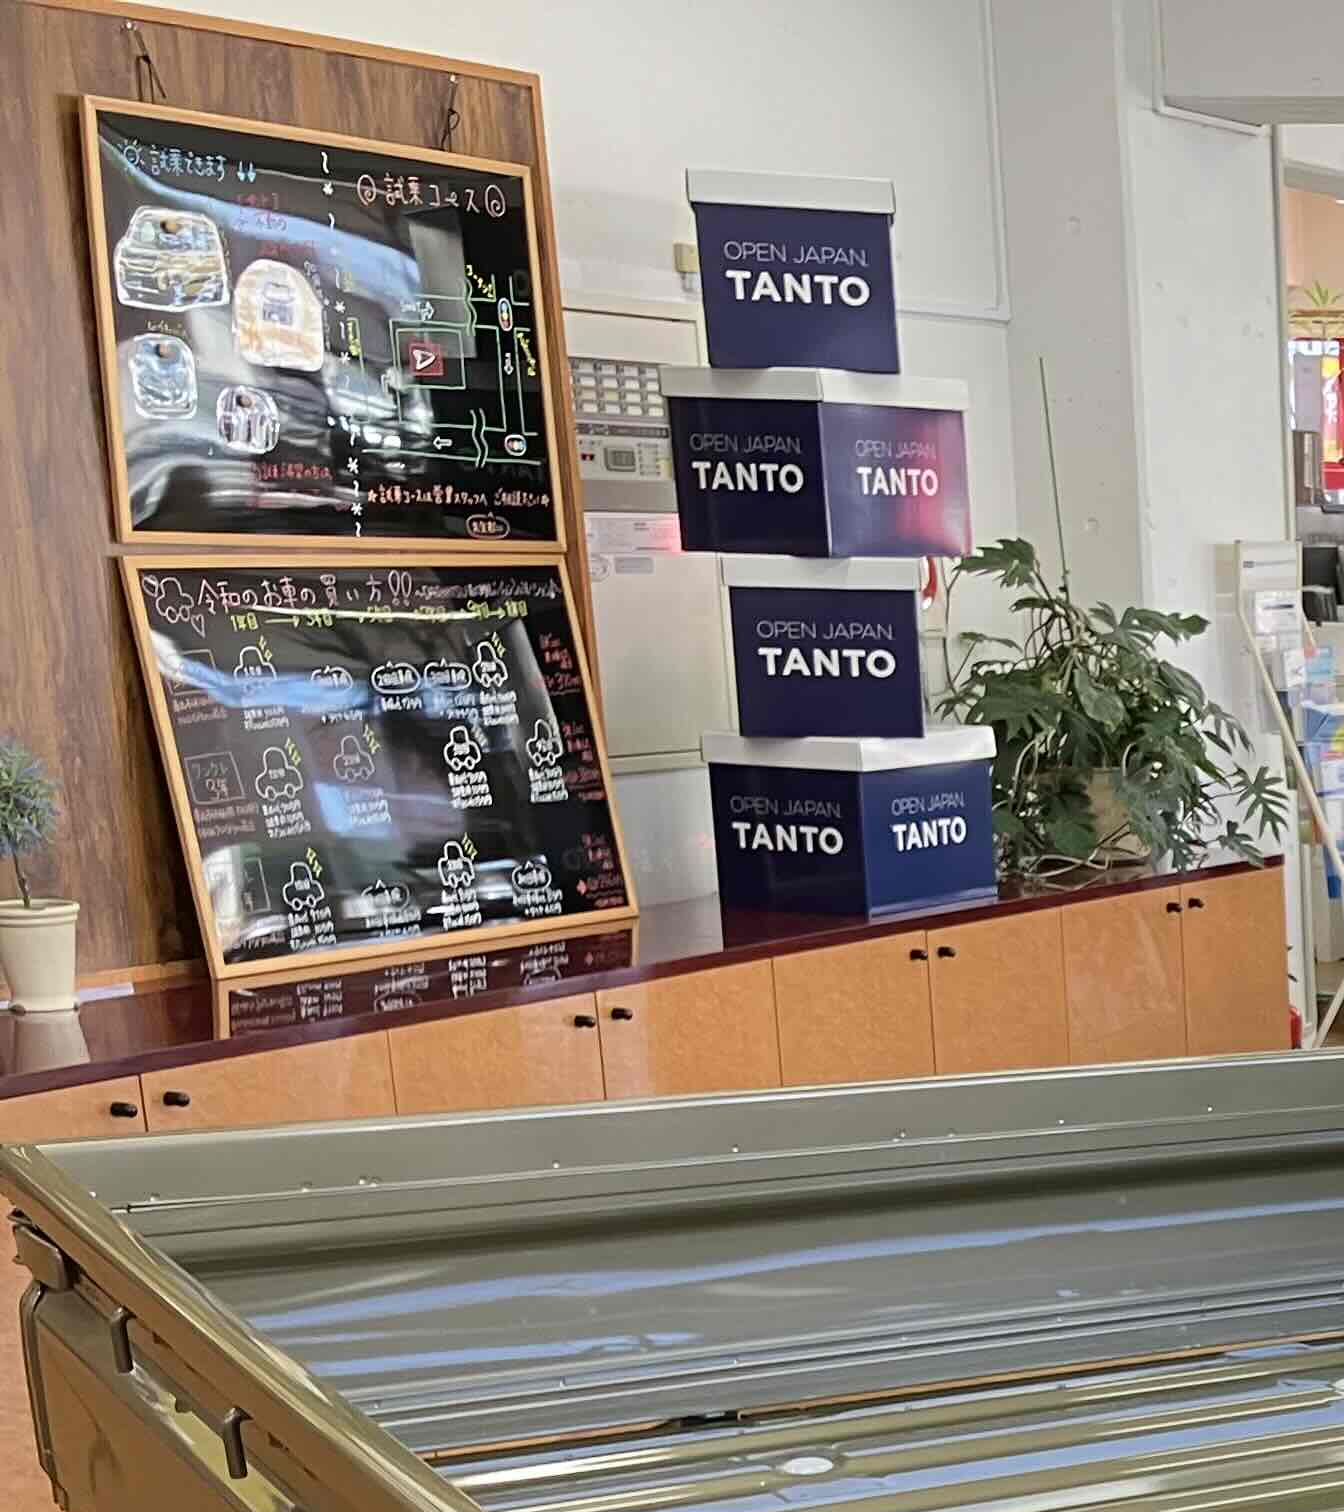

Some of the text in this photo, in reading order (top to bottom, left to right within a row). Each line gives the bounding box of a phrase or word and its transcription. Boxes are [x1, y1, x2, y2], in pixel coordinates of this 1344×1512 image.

[724, 241, 787, 262] OPEN
[725, 269, 870, 306] TANTO
[690, 433, 738, 452] OPEN
[855, 440, 892, 457] OPEN
[692, 461, 804, 493] TANTO
[856, 466, 939, 496] TANTO
[756, 620, 817, 639] OPEN
[757, 647, 896, 678] TANTO
[729, 796, 778, 815] OPEN
[891, 797, 924, 816] OPEN
[732, 821, 843, 854] TANTO
[892, 816, 967, 851] TANTO
